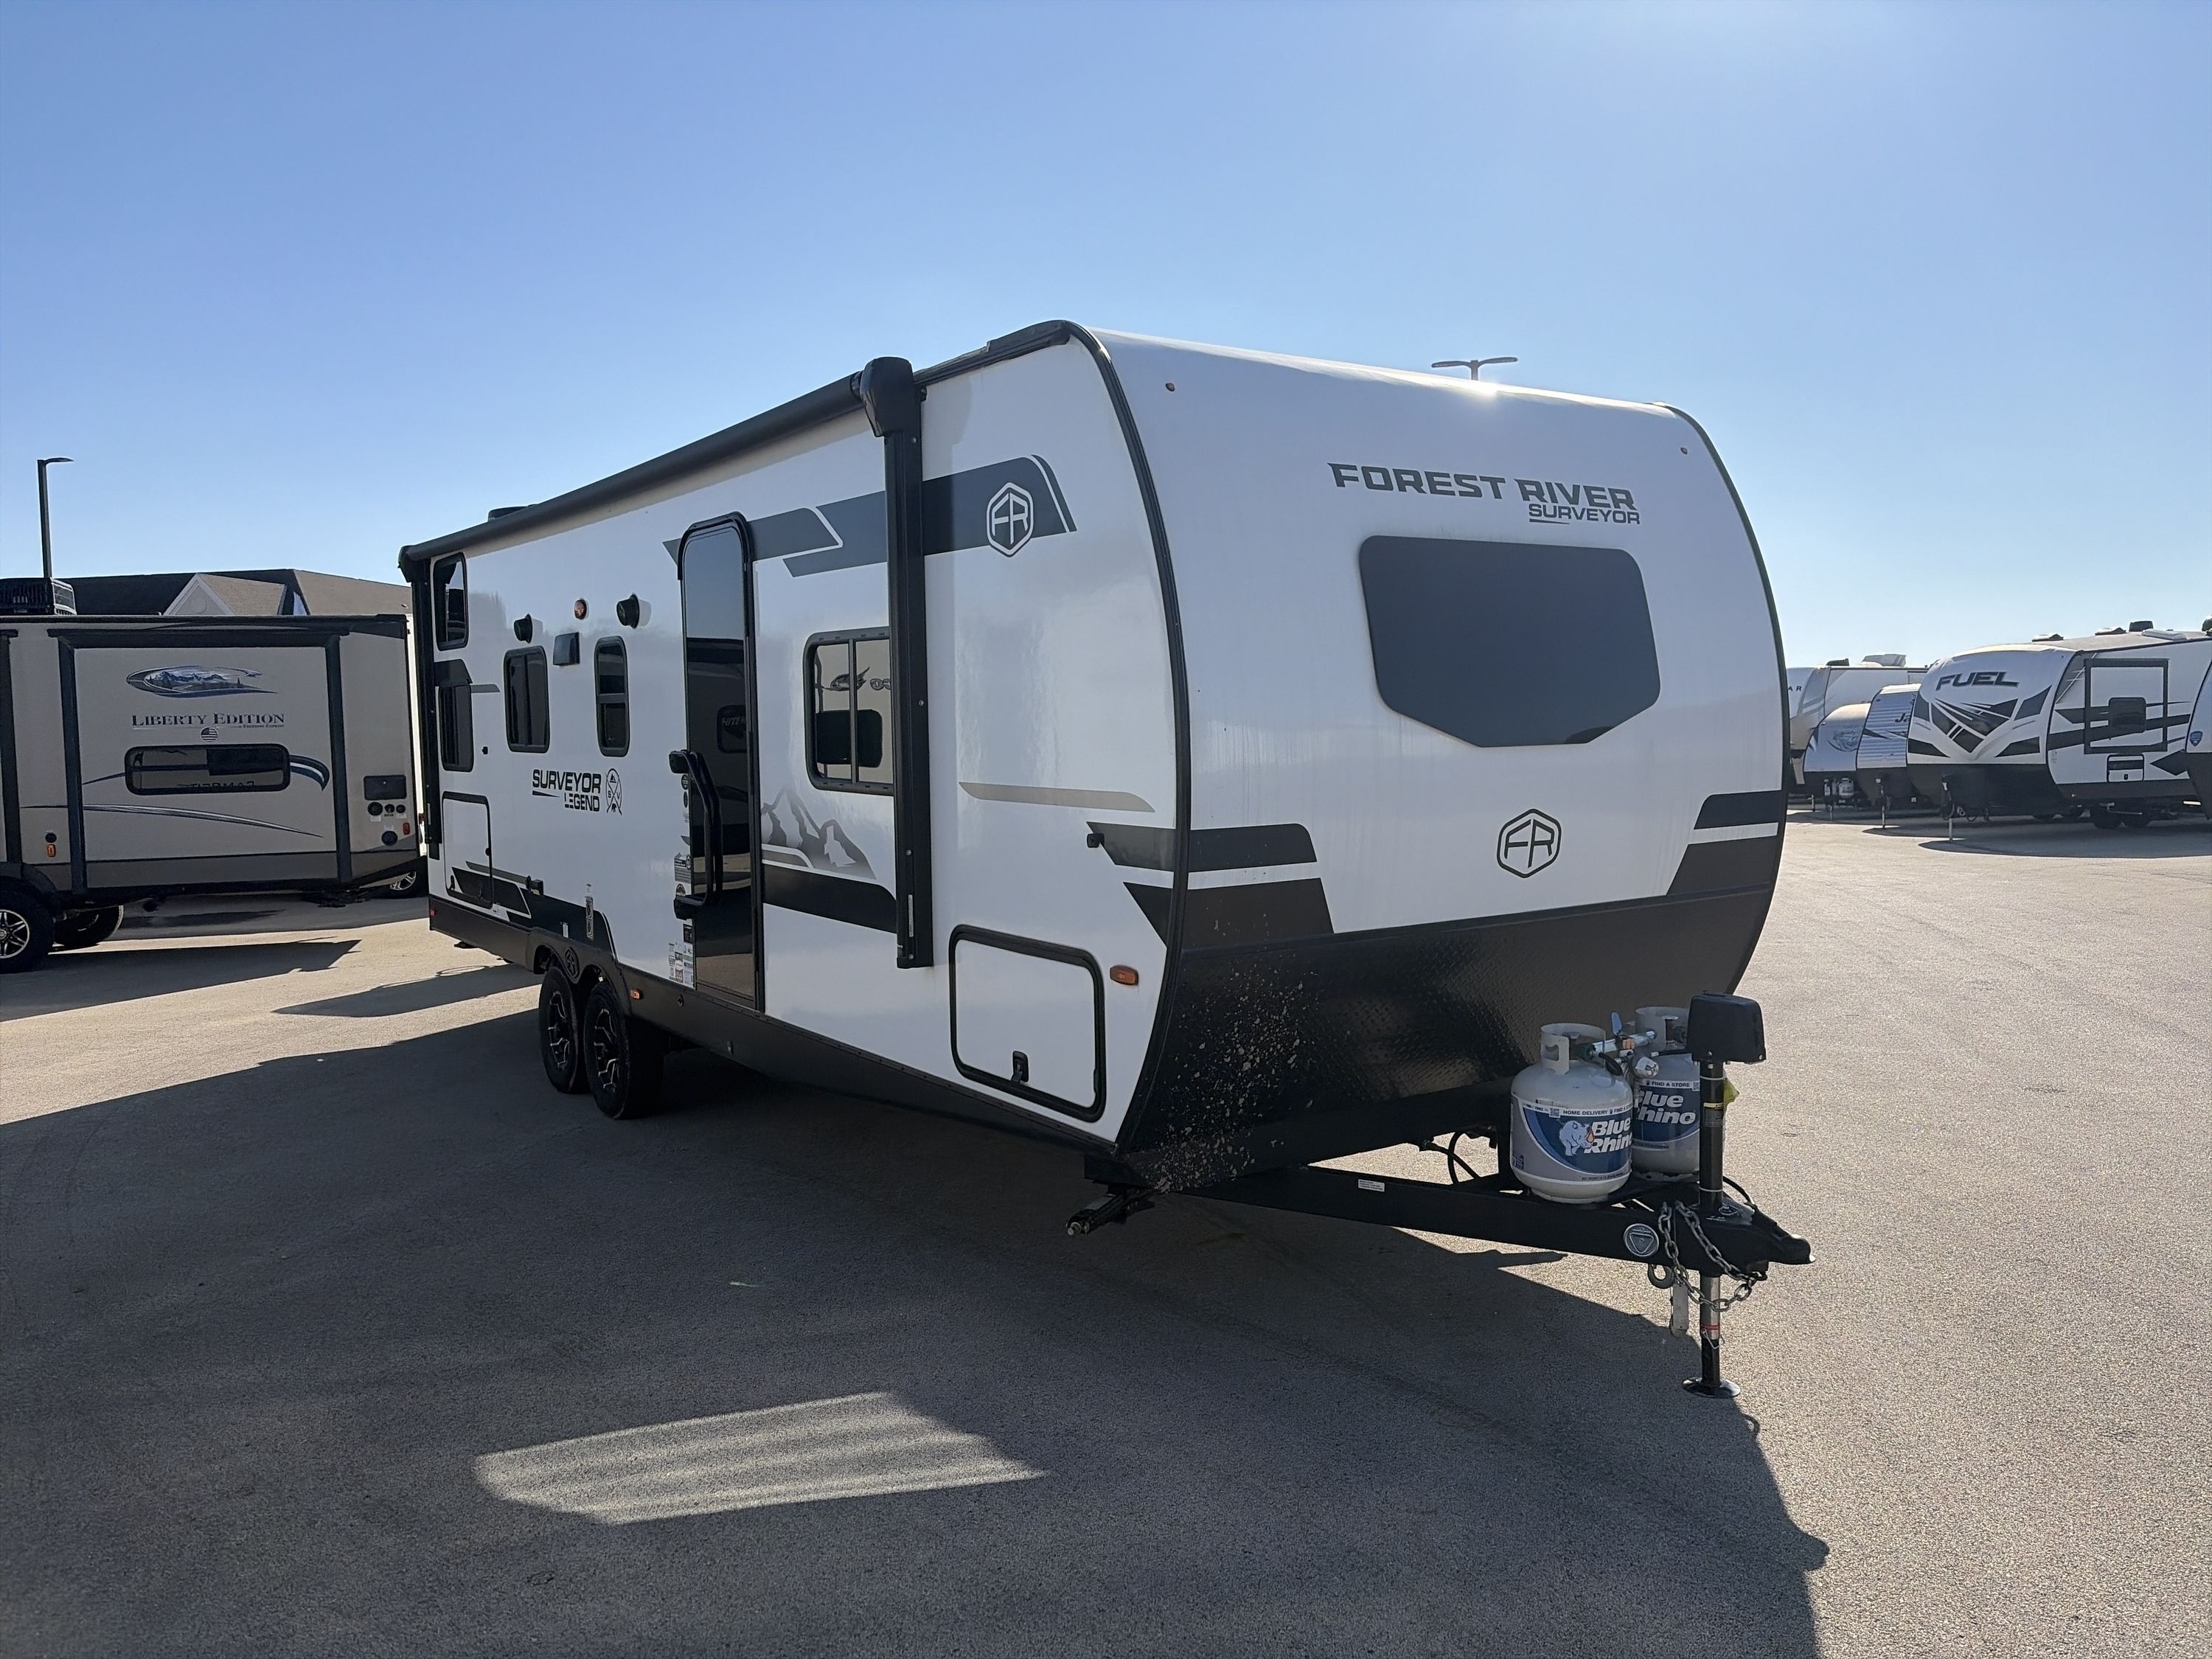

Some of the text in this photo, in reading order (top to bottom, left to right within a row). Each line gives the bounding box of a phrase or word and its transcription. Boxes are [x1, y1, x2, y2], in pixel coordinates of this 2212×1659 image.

[1327, 462, 1638, 510] FOREST RIVER
[1528, 504, 1641, 525] SURVEYOR
[1935, 671, 2020, 692] FUEL
[132, 712, 285, 726] LIBERTY EDITION
[532, 769, 602, 794] SURVEYOR
[564, 792, 600, 813] LEGEND
[1636, 1106, 1697, 1124] hino
[1591, 1116, 1631, 1136] Blue
